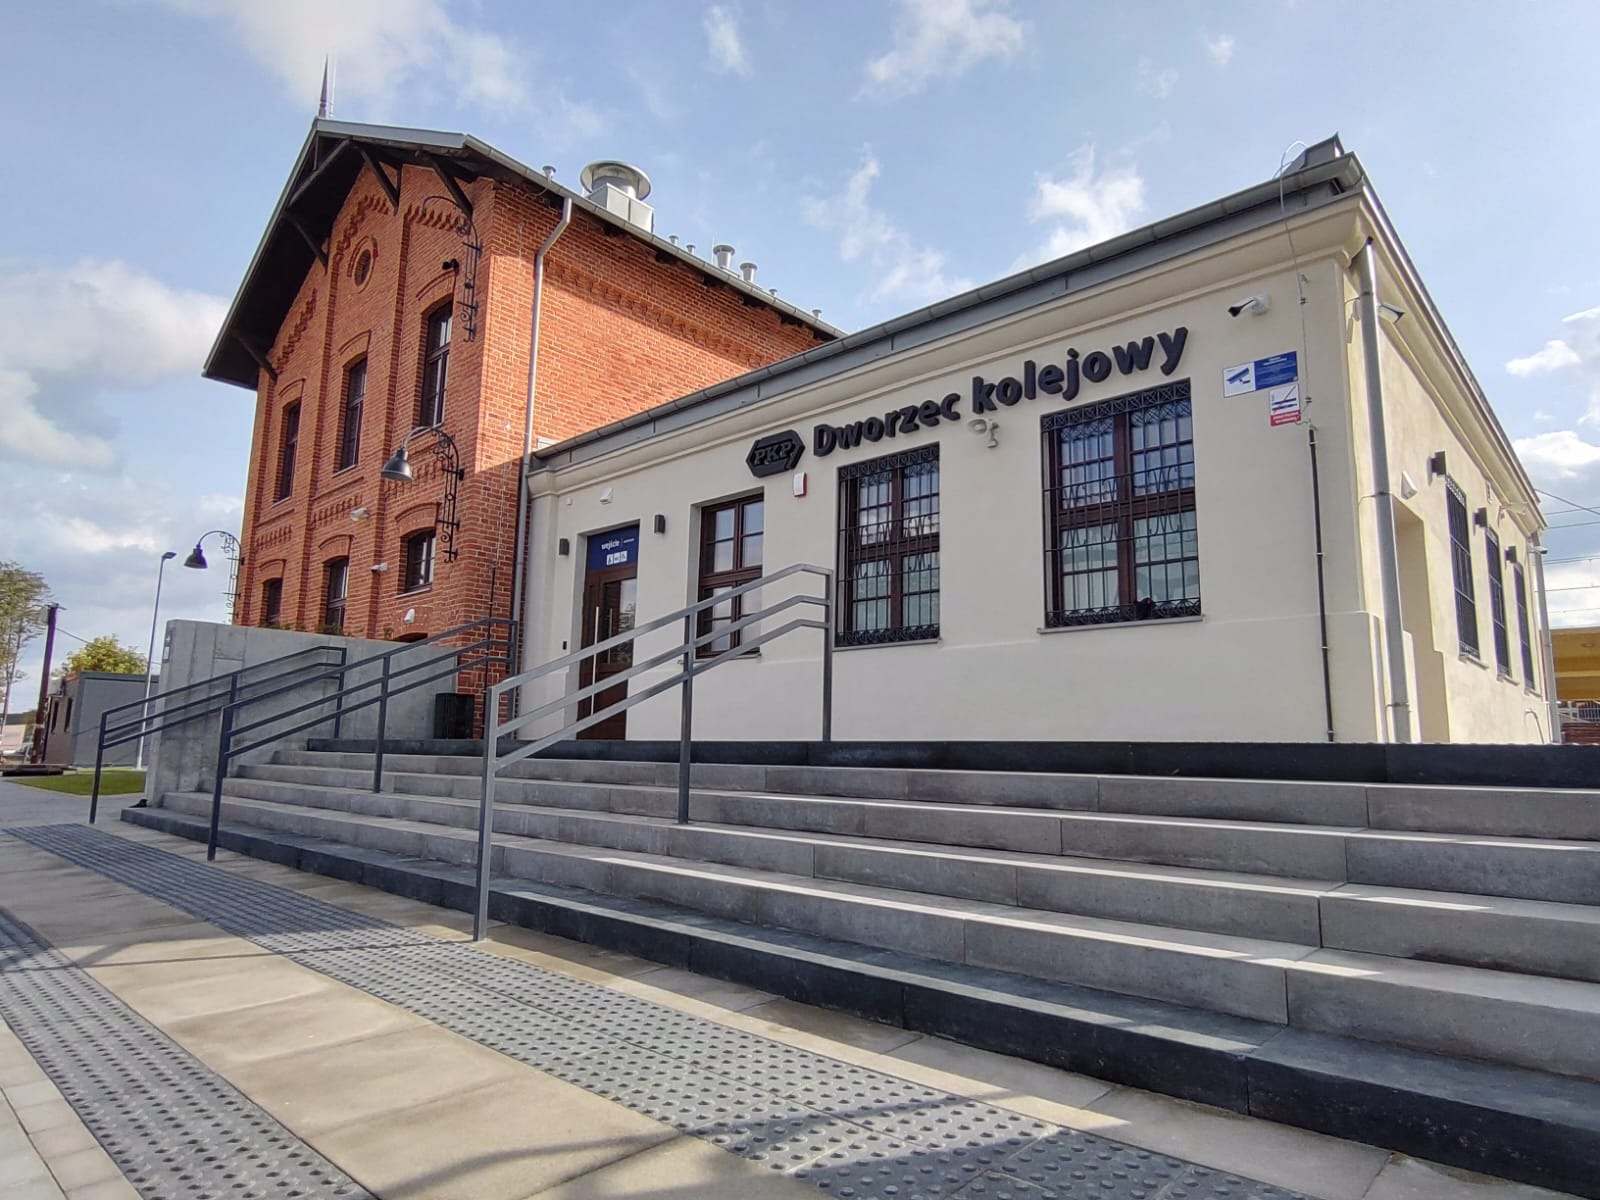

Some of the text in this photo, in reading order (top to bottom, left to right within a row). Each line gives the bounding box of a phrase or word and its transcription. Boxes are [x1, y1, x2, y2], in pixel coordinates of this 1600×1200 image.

[813, 326, 1189, 457] Dworzec kolejowy
[753, 440, 792, 465] PKP
